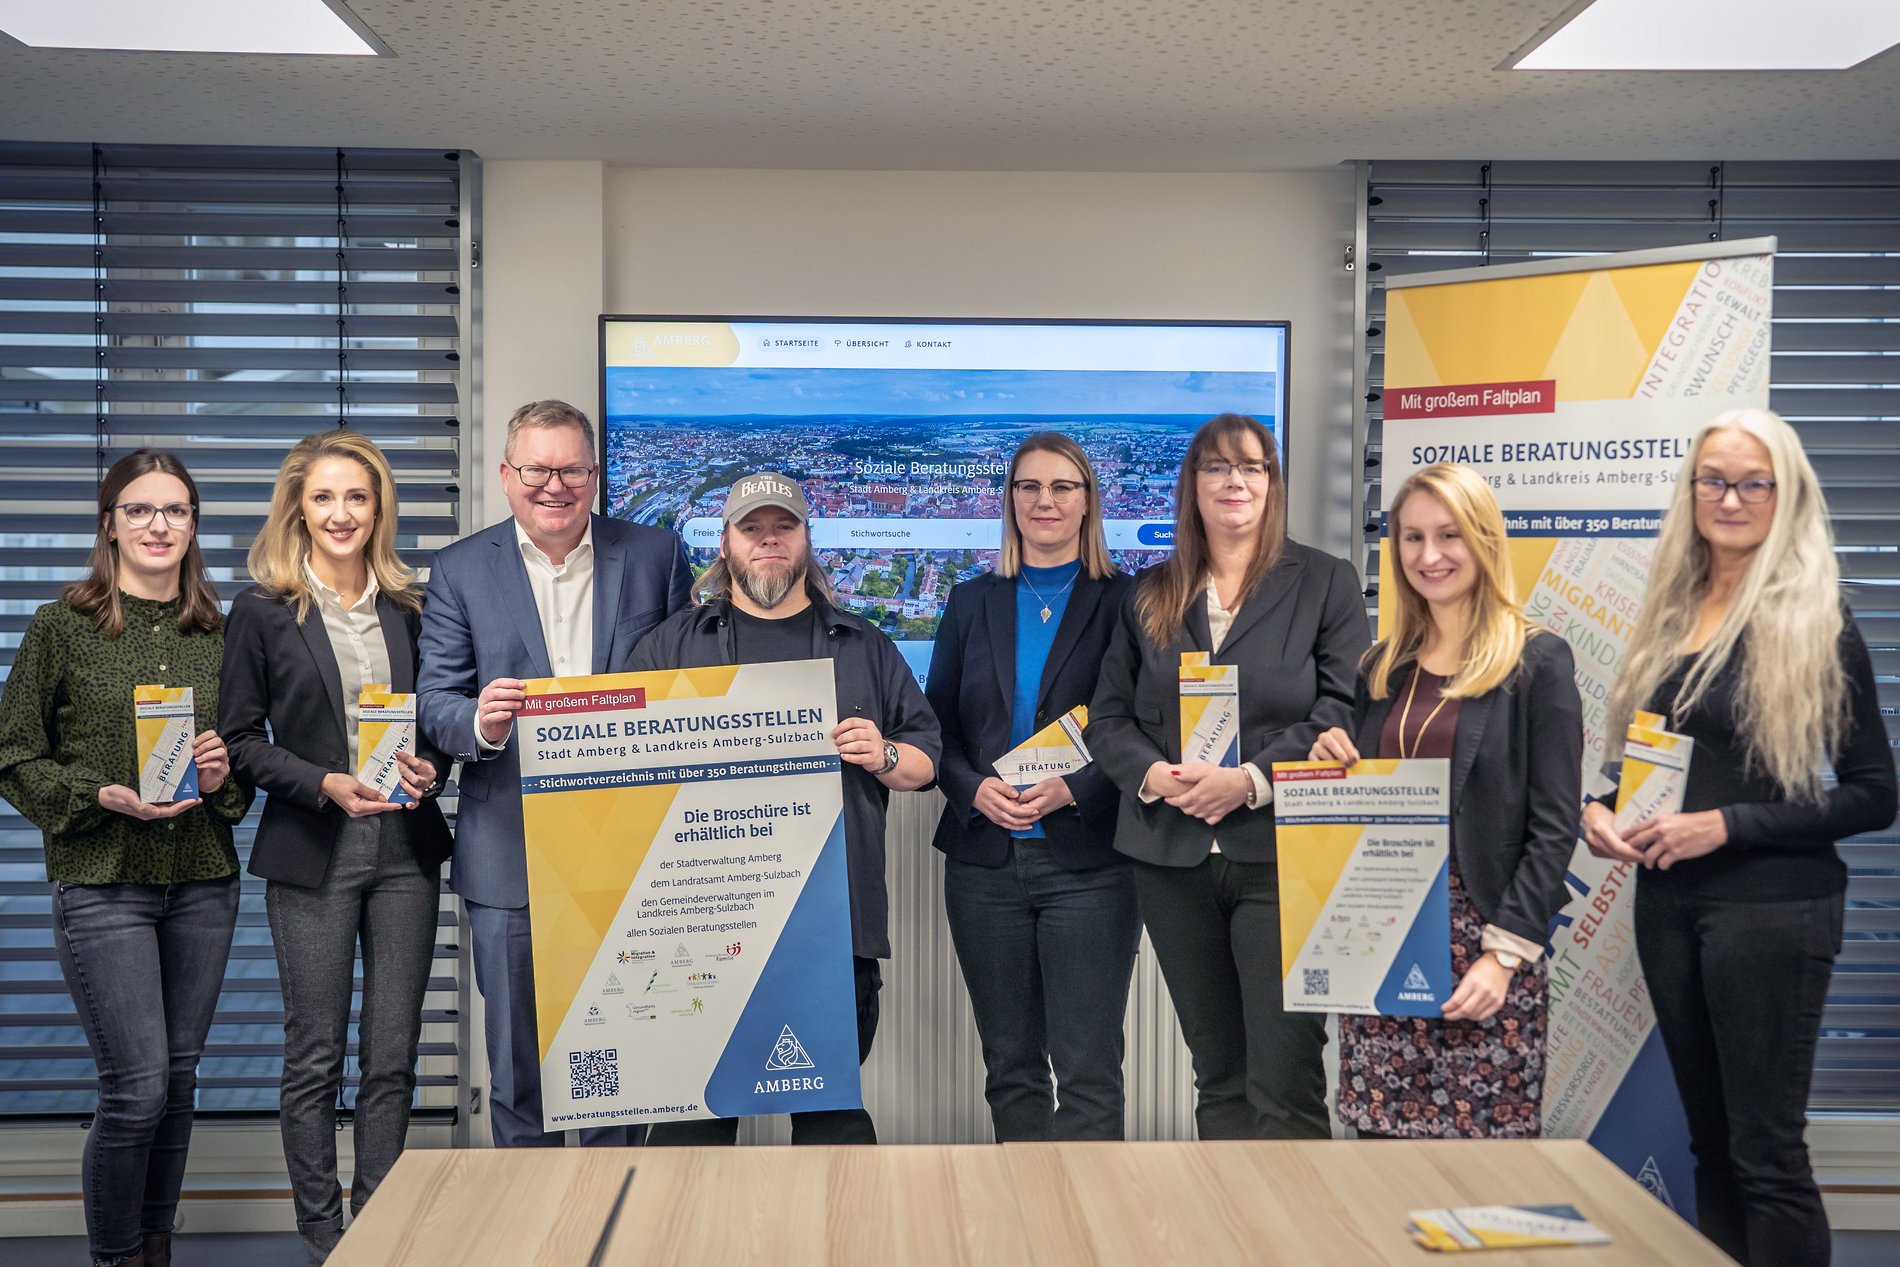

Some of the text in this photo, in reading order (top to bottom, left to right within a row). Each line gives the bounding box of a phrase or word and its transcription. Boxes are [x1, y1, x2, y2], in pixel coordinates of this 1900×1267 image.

[1716, 291, 1762, 322] GEWALT
[654, 335, 711, 346] AMBERG
[775, 339, 819, 348] STARTSEITE
[847, 338, 889, 348] ÜBERSICHT
[917, 340, 952, 348] KONTAKT
[1401, 387, 1541, 412] Mit großem Faltplan
[1412, 444, 1494, 465] SOZIALE
[855, 461, 906, 475] Soziale
[1507, 473, 1516, 485] &
[1522, 471, 1590, 485] Landkreis
[742, 481, 793, 498] BEATLES
[850, 485, 872, 494] Stadt
[874, 485, 908, 496] Amberg
[910, 485, 917, 494] &
[919, 485, 960, 495] Landkreis
[693, 529, 715, 537] Freie
[1531, 516, 1552, 529] mit
[1555, 516, 1583, 529] über
[1586, 519, 1609, 532] 350
[851, 529, 911, 539] Stichwortsuche
[525, 692, 637, 711] Mit großem Faltplan
[537, 707, 824, 743] SOZIALE BERATUNGSSTELLEN
[1200, 710, 1231, 761] BERATUNG
[538, 730, 825, 761] Stadt Amberg & Landkreis Amberg-Sulzbach
[159, 731, 189, 783] BERATUNG
[1019, 761, 1071, 772] BERATUNG
[540, 759, 827, 790] Stichwortverzeichnis mit über 350 Beratungsthemen
[1284, 786, 1440, 798] SOZIALE BERATUNGSSTELLEN
[684, 802, 812, 825] Die Broschüre ist
[674, 823, 774, 844] erhältlich bei
[660, 852, 782, 870] der Stadtverwaltung Amberg
[651, 869, 801, 889] dem Landratsamt Amberg-Sulzbach
[641, 889, 776, 908] den Gemeindeverwaltungen im
[637, 902, 755, 919] Landkreis Amberg-Sulzbach
[627, 919, 757, 938] allen Sozialen Beratungsstellen
[1398, 991, 1435, 1002] AMBERG
[1582, 968, 1649, 1034] FRAUEN
[1573, 986, 1637, 1048] BESTATTUNG
[754, 1076, 825, 1094] AMBERG
[1583, 1059, 1609, 1097] KINDER
[1544, 1048, 1598, 1137] ALTERSVORSORGE
[552, 1102, 698, 1123] www.beratungsstellen.amberg.de
